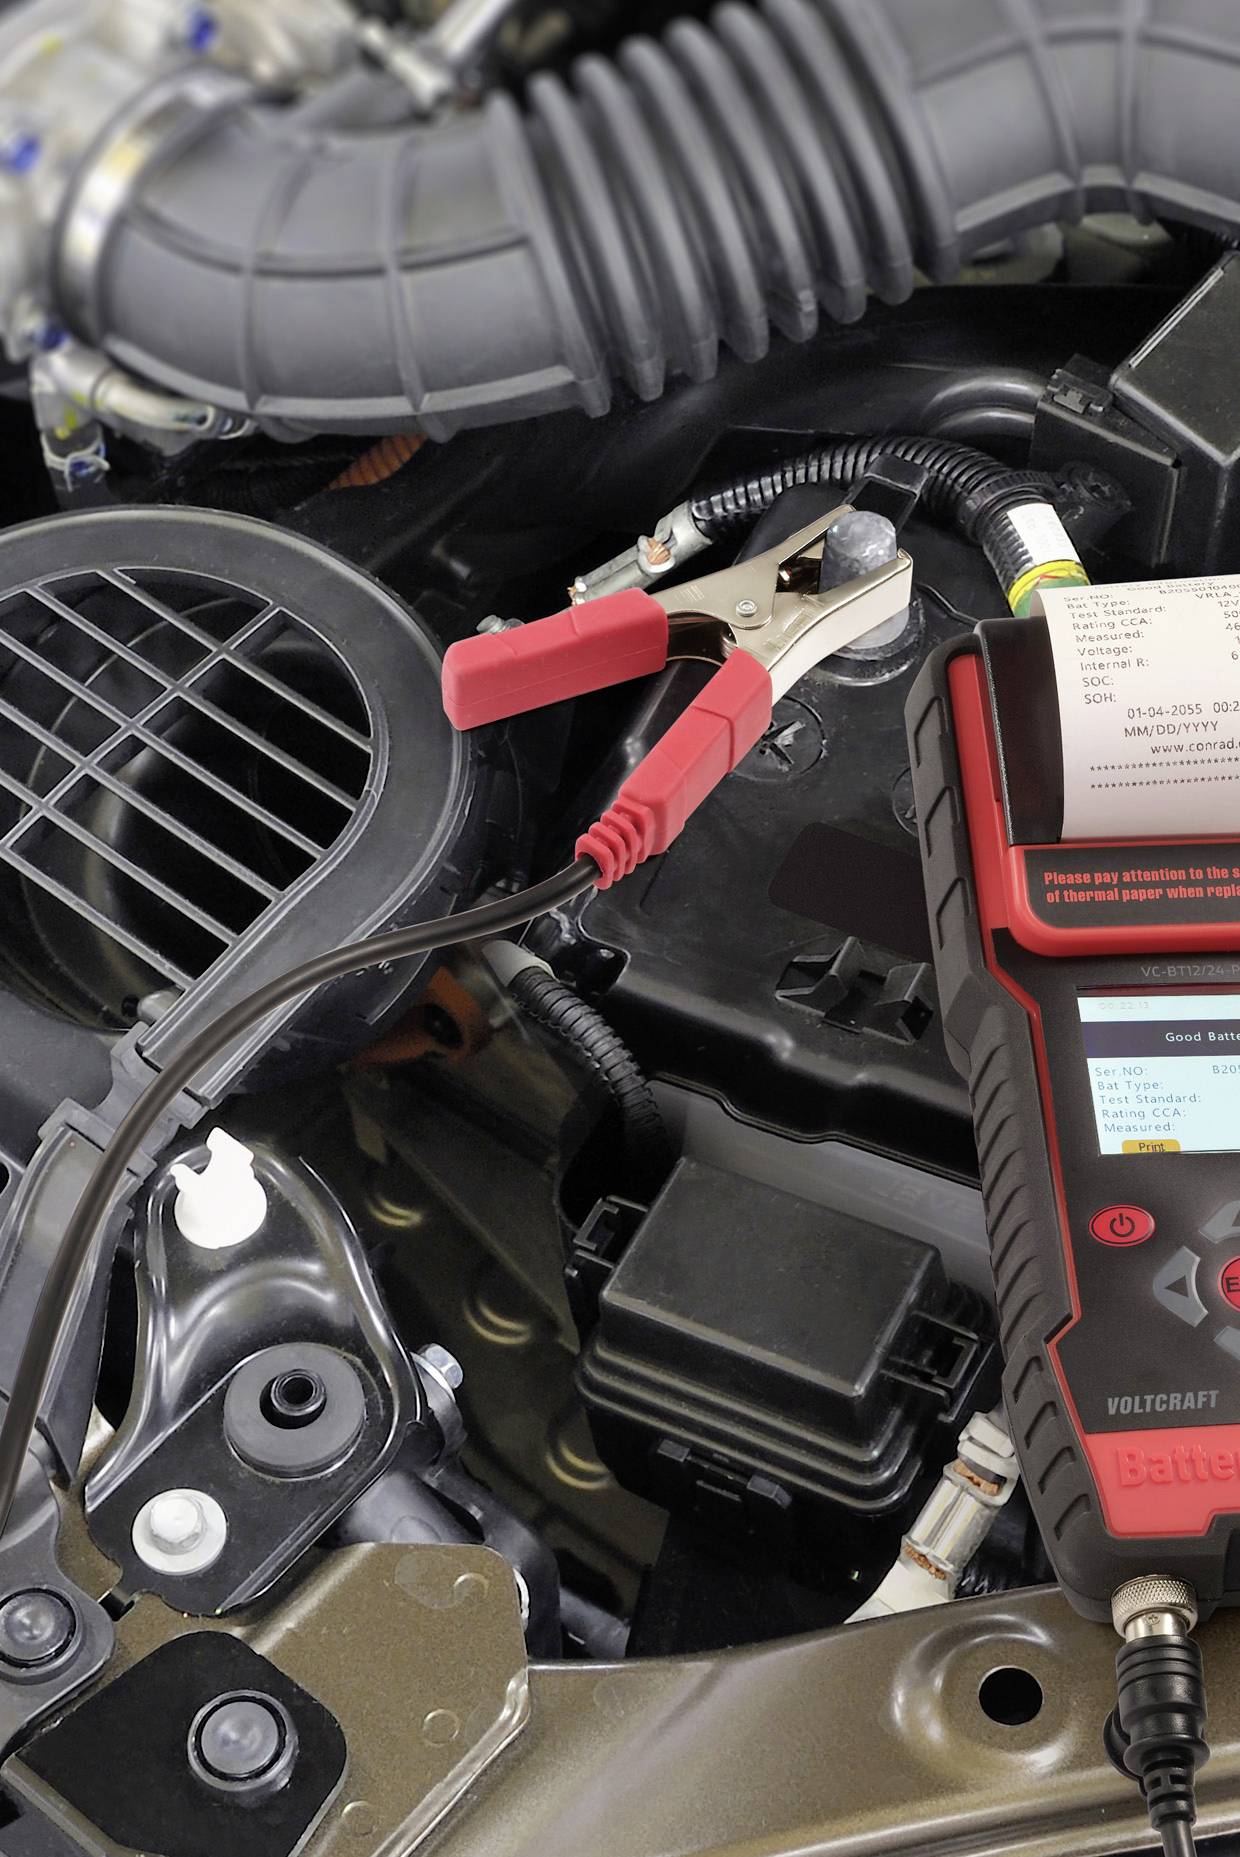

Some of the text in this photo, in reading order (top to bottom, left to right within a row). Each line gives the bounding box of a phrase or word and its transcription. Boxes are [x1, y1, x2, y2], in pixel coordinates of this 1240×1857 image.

[1067, 602, 1089, 610] Bat
[1094, 600, 1130, 609] Type:
[1070, 610, 1098, 620] Test
[1103, 605, 1167, 618] Standard:
[1072, 619, 1115, 631] Rating
[1121, 617, 1152, 627] CCA:
[1075, 630, 1144, 643] Measured:
[1077, 645, 1133, 658] Voltage:
[1080, 659, 1131, 672] Internal
[1136, 658, 1150, 668] R:
[1082, 676, 1115, 688] SOC:
[1084, 693, 1117, 705] SOH:
[1127, 703, 1203, 720] 01-04-2055
[1123, 720, 1219, 738] MM/DD/YYYY
[1043, 870, 1091, 885] Please
[1094, 870, 1118, 885] pay
[1122, 867, 1187, 883] attention
[1189, 867, 1204, 880] to
[1206, 866, 1229, 879] the
[1046, 889, 1061, 904] of
[1063, 887, 1120, 903] thermal
[1122, 888, 1163, 903] paper
[1166, 885, 1204, 899] when
[1165, 1032, 1202, 1043] Good
[1095, 1066, 1148, 1077] Ser.NO:
[1097, 1081, 1120, 1091] Bat
[1126, 1080, 1164, 1092] Type:
[1099, 1094, 1129, 1105] Test
[1136, 1092, 1201, 1105] Standard:
[1101, 1108, 1146, 1120] Rating
[1152, 1107, 1187, 1118] CCA:
[1104, 1122, 1175, 1133] Measured:
[1138, 1141, 1166, 1153] Print
[1107, 1389, 1219, 1415] VOLTCRAFT
